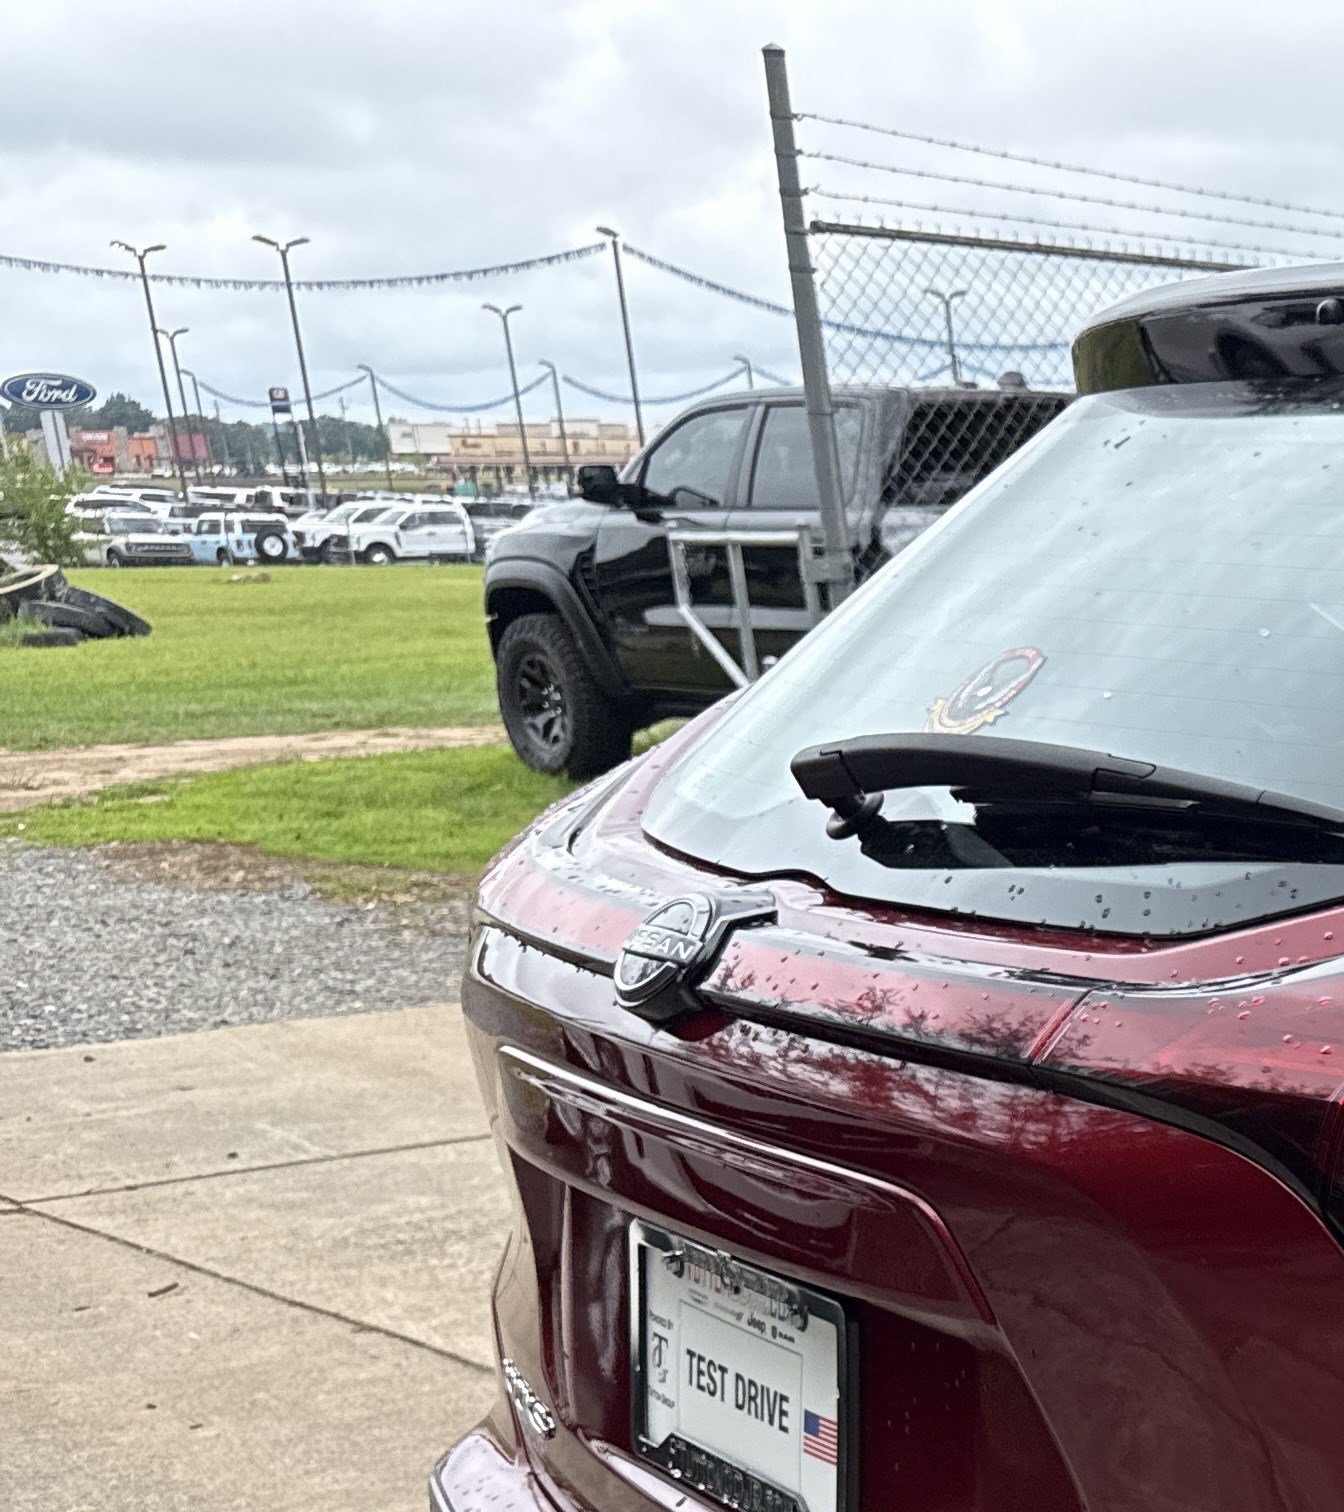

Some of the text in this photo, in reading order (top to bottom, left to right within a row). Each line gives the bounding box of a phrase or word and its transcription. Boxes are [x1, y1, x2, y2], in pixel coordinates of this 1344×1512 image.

[22, 378, 79, 403] Ford
[686, 1347, 729, 1403] TEST
[735, 1371, 790, 1435] DRIVE
